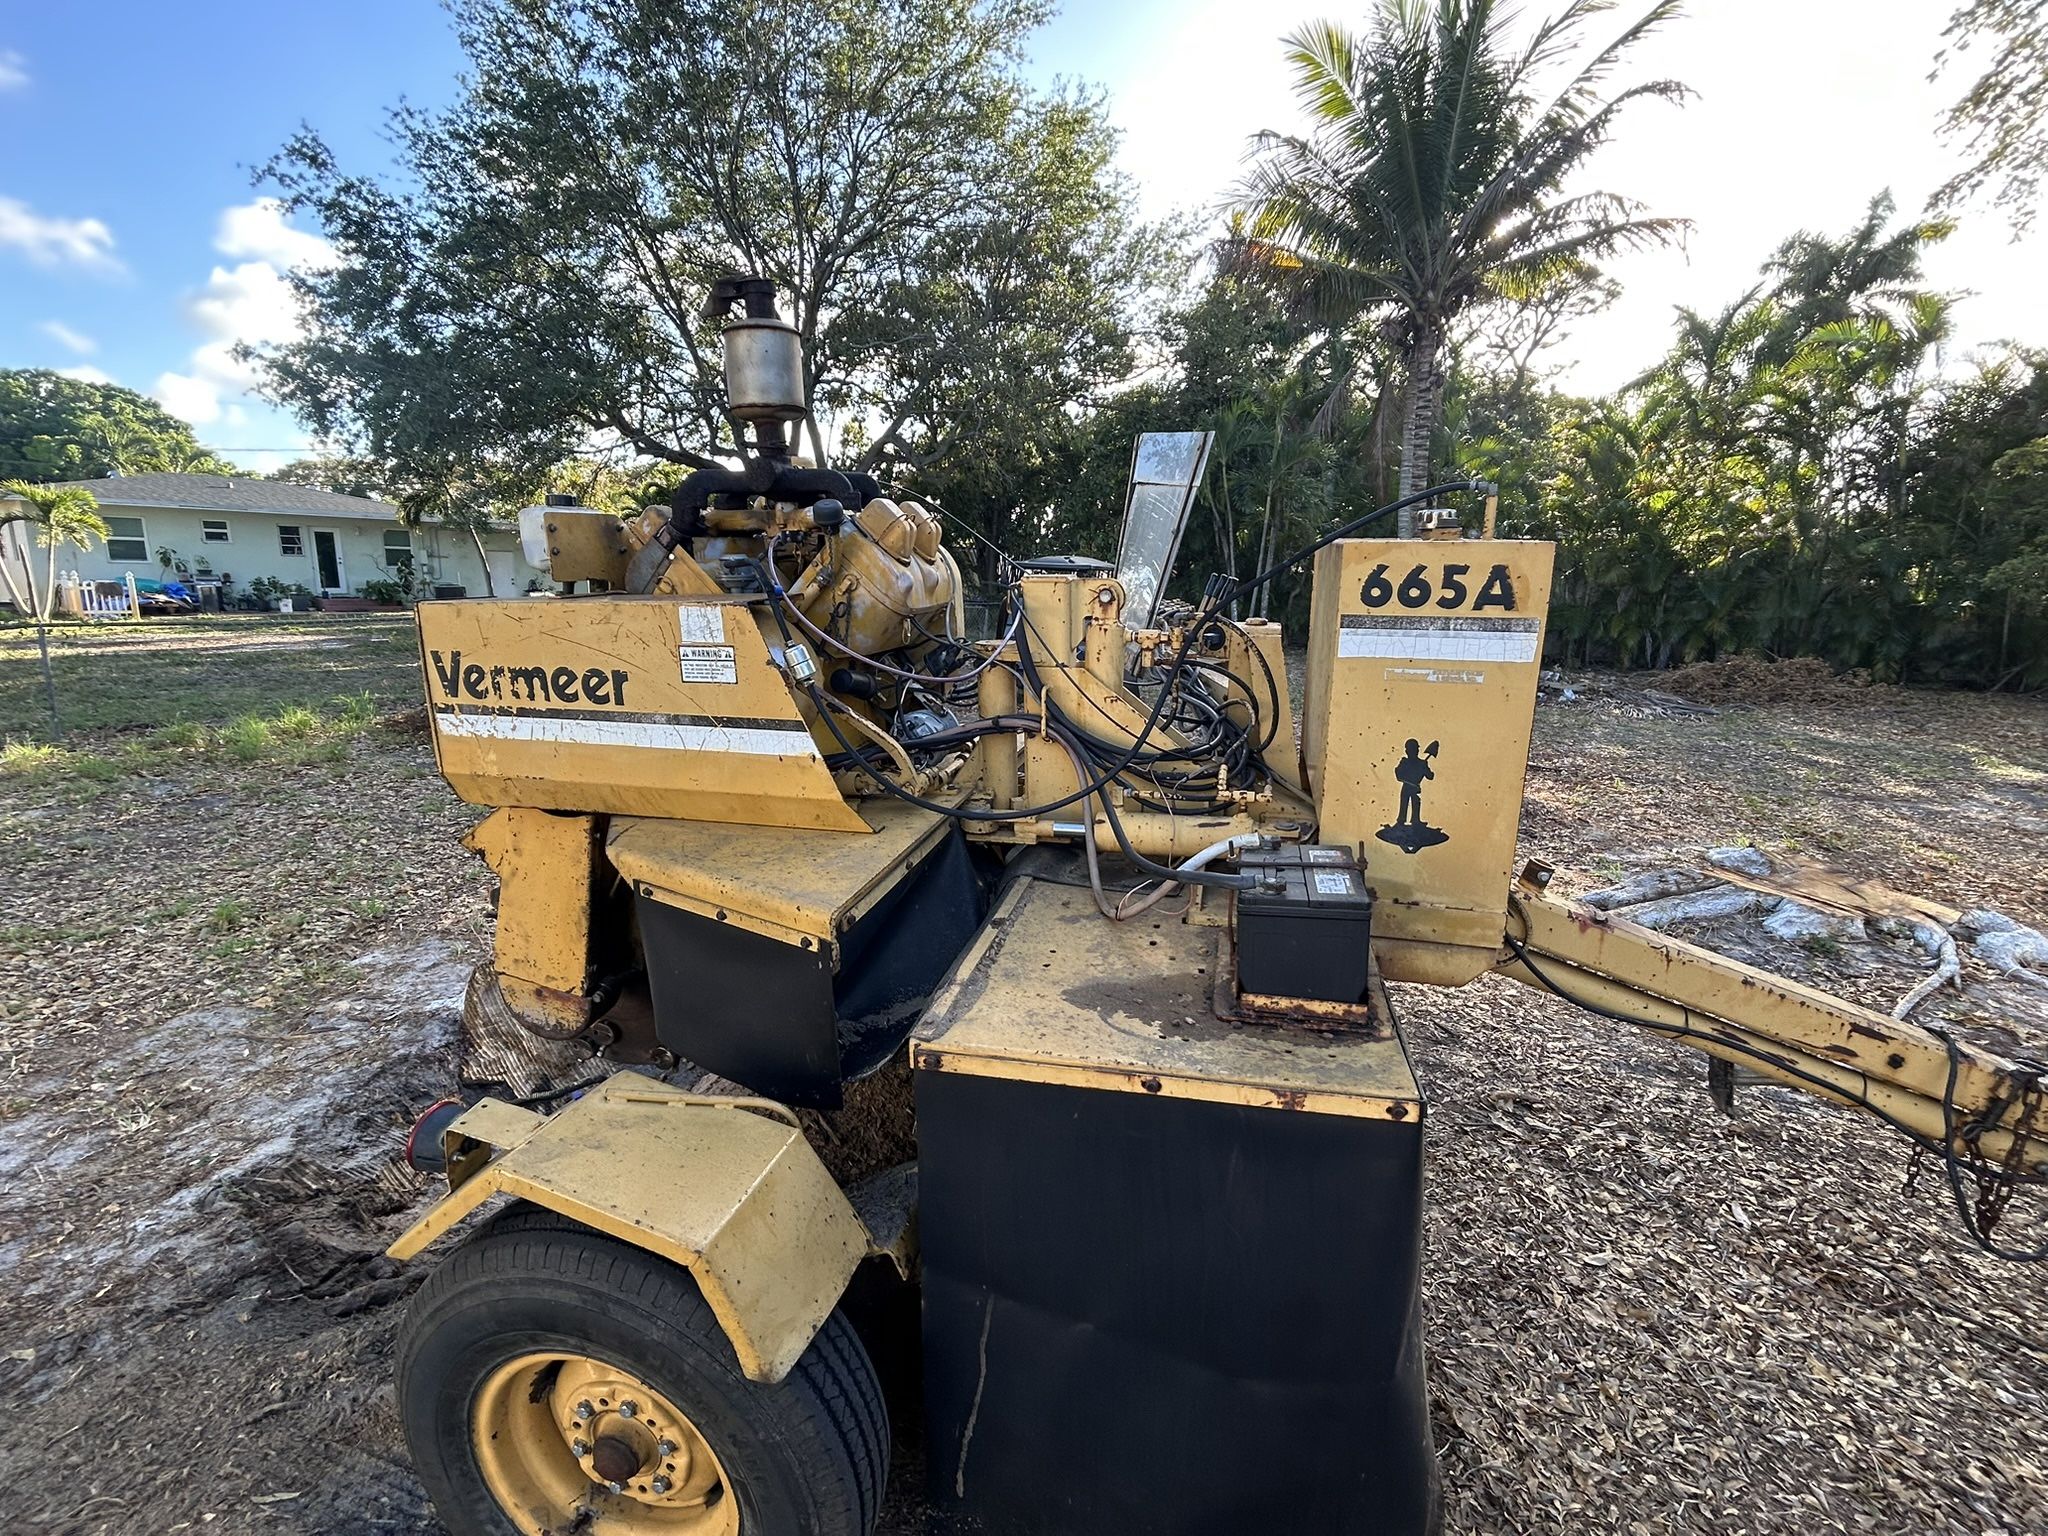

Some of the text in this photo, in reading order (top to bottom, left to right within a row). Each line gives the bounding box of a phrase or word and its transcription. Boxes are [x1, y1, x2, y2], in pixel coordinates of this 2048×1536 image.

[1360, 564, 1517, 611] 665A
[690, 649, 723, 658] WARNING
[430, 650, 629, 706] Vermeer
